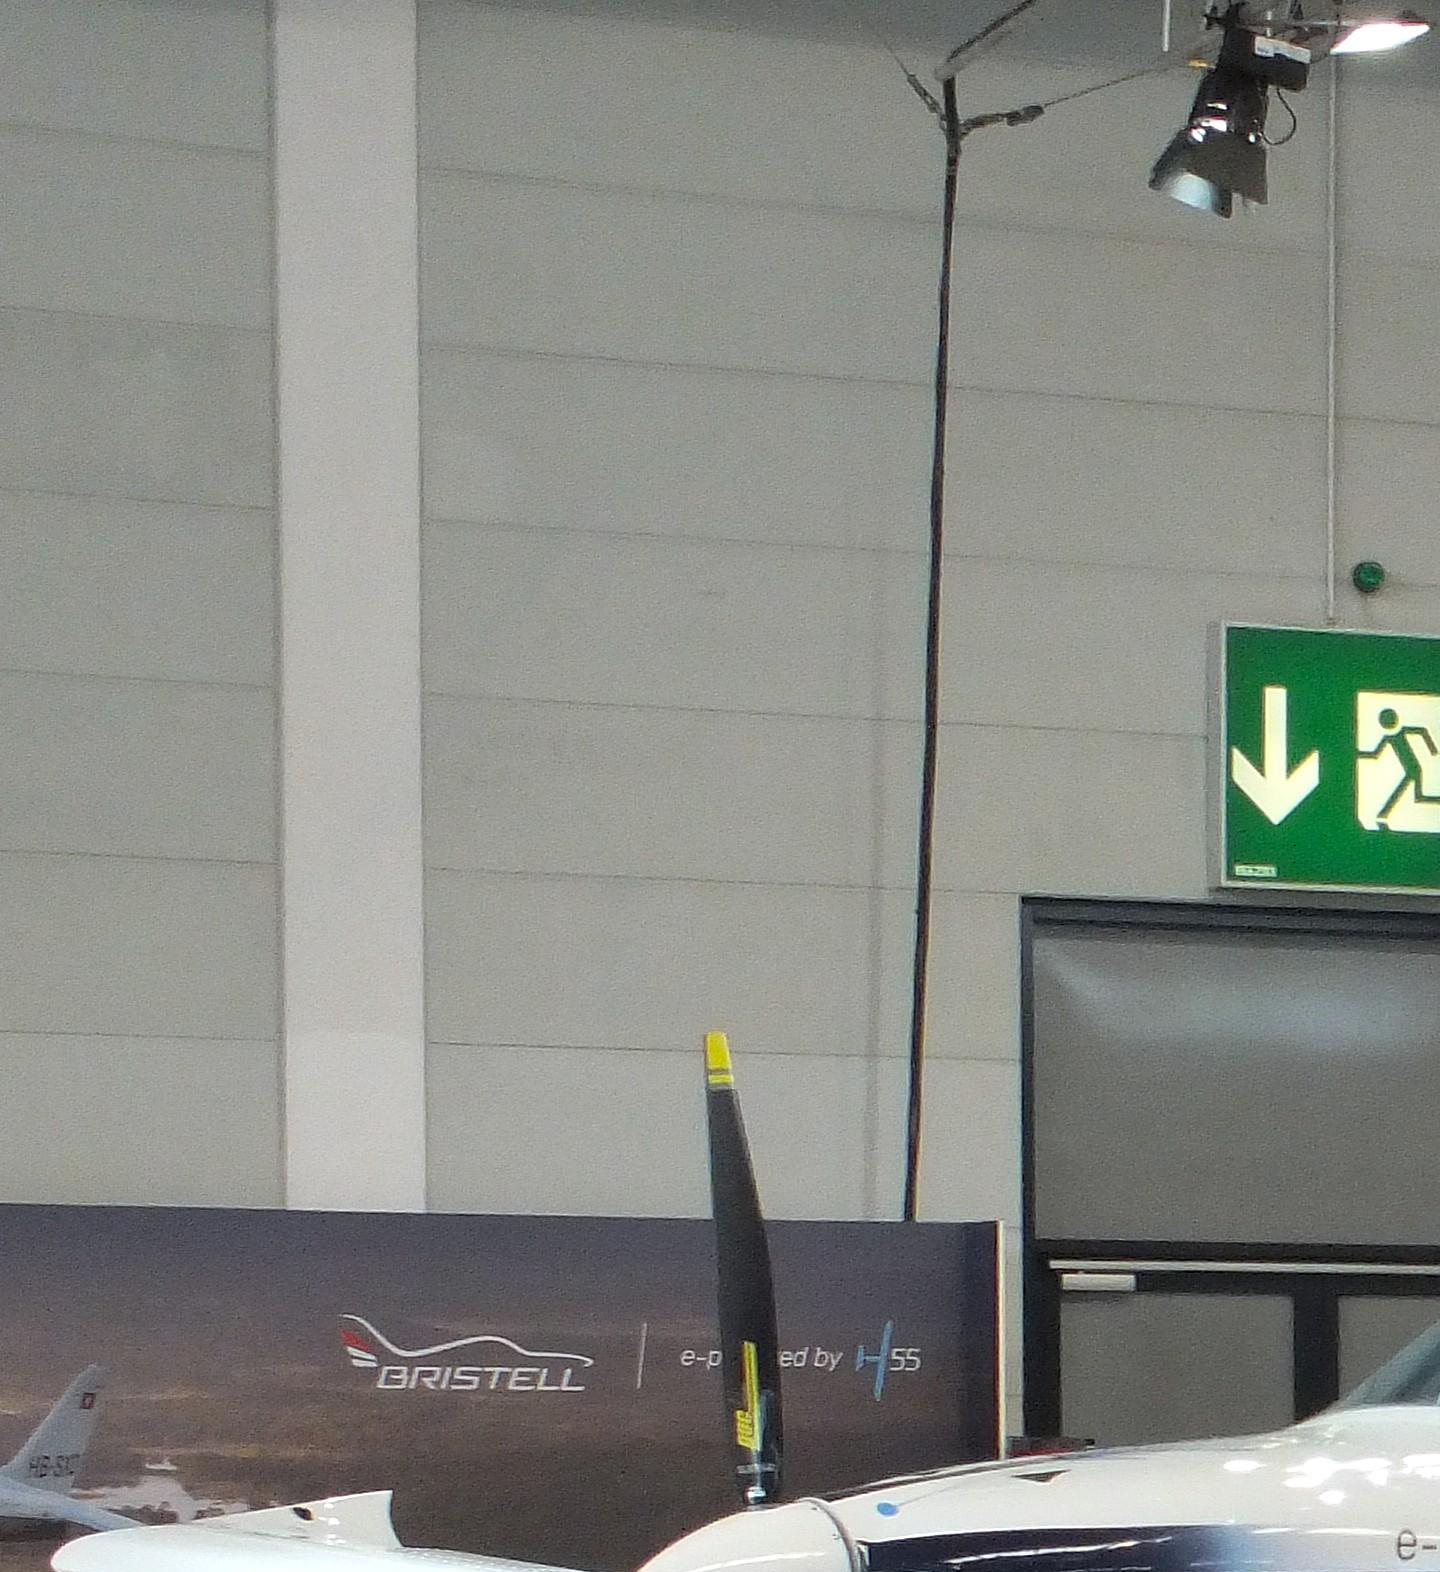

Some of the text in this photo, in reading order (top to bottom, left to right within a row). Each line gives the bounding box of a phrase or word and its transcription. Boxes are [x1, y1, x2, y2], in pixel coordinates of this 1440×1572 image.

[680, 1347, 809, 1371] e-ped
[813, 1347, 844, 1371] by
[377, 1366, 586, 1391] BRISTELL
